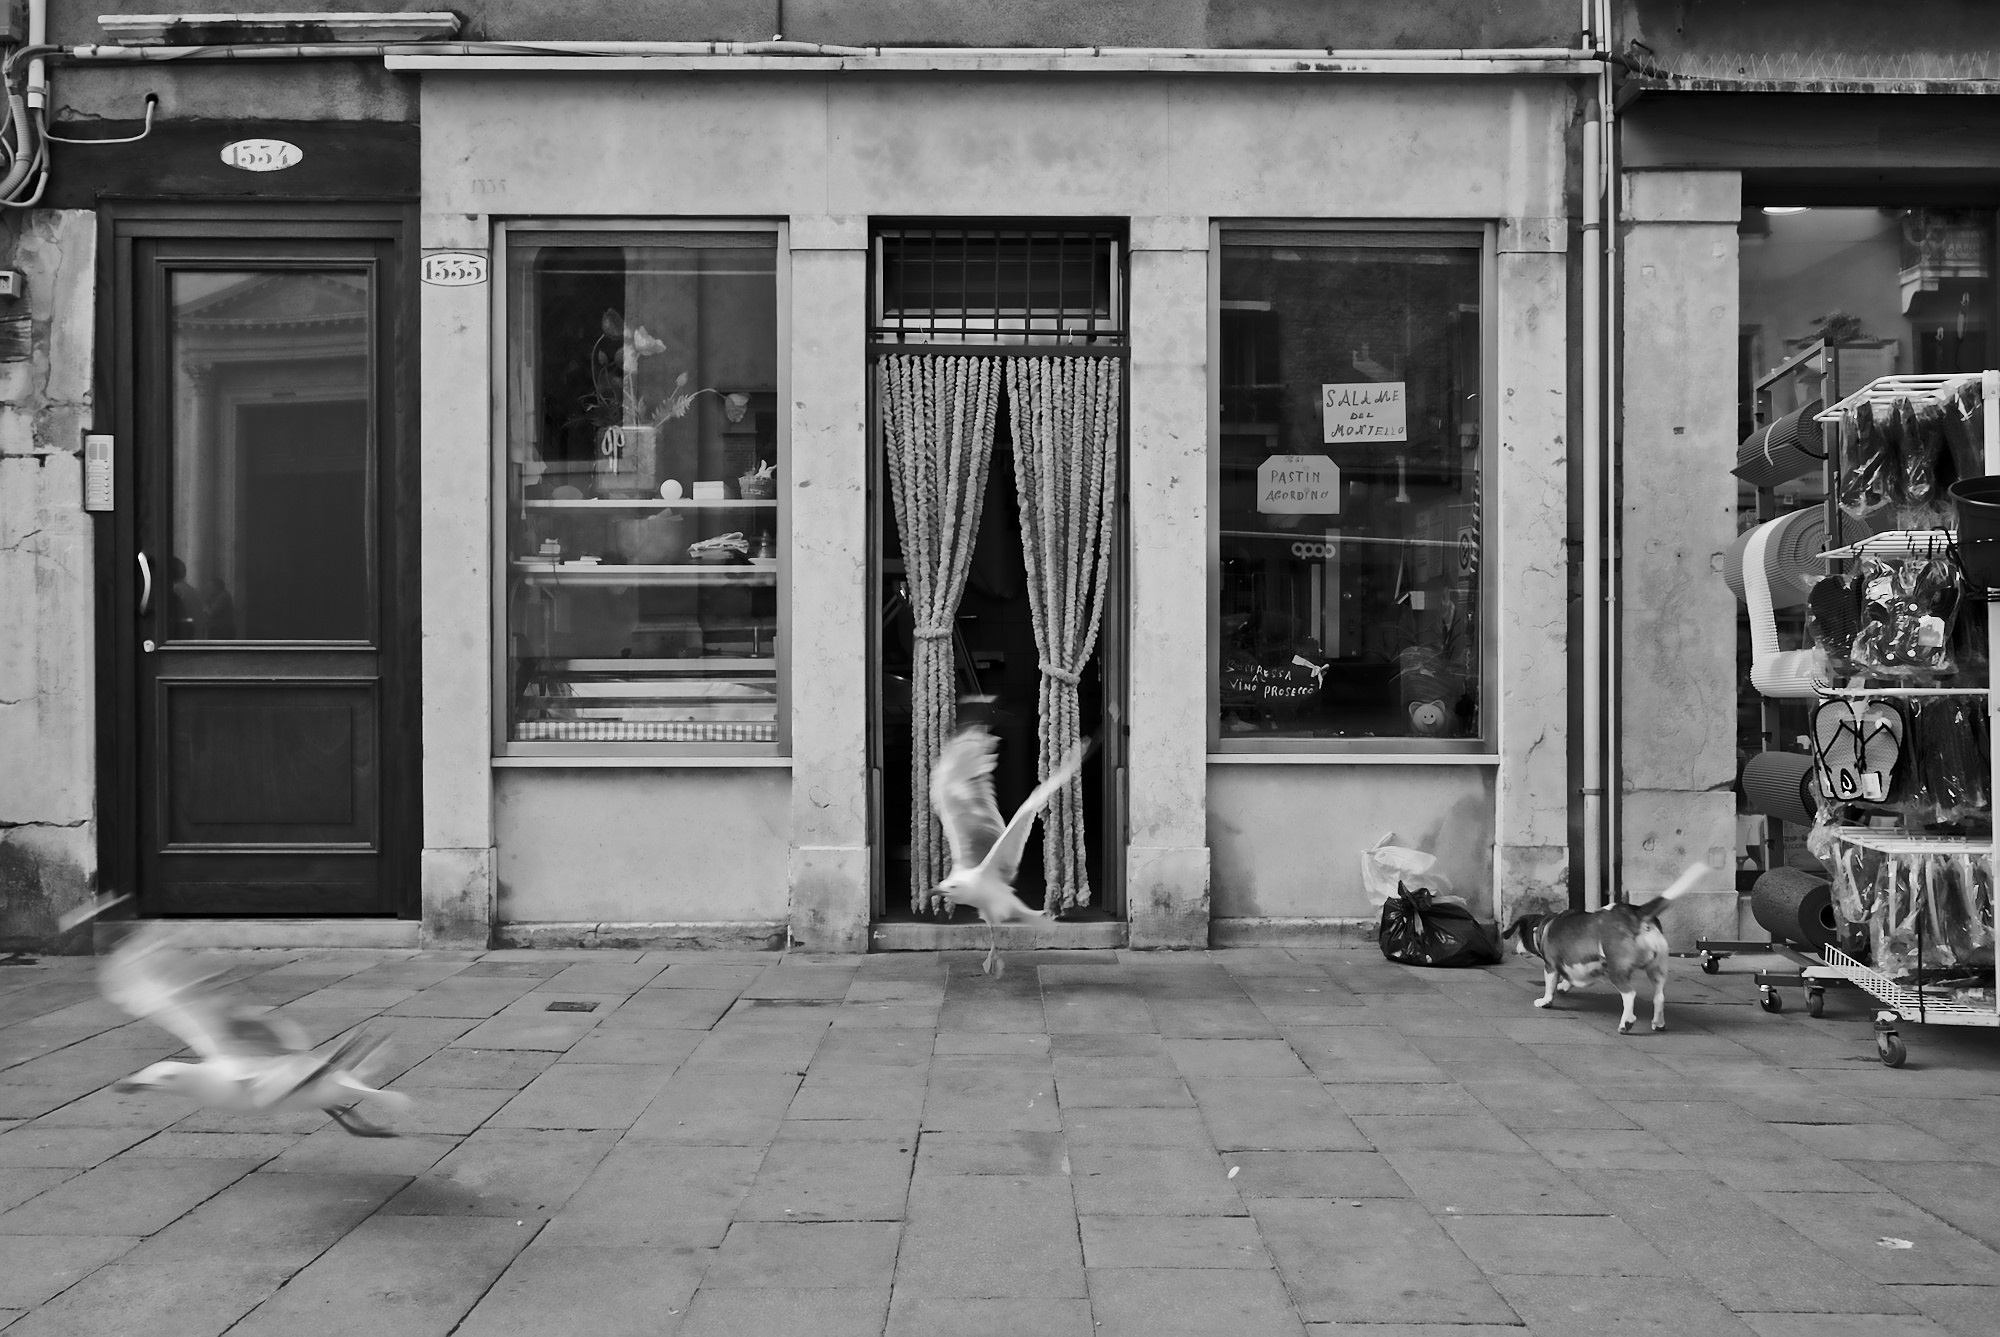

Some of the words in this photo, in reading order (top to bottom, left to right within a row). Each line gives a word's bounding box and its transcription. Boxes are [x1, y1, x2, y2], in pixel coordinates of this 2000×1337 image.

[426, 260, 482, 280] 1335
[1326, 389, 1400, 408] SALAME
[1350, 412, 1374, 420] DEL
[1331, 424, 1405, 437] MONTELLO
[1270, 470, 1321, 484] PASTIN
[1265, 490, 1329, 502] AGORDINO
